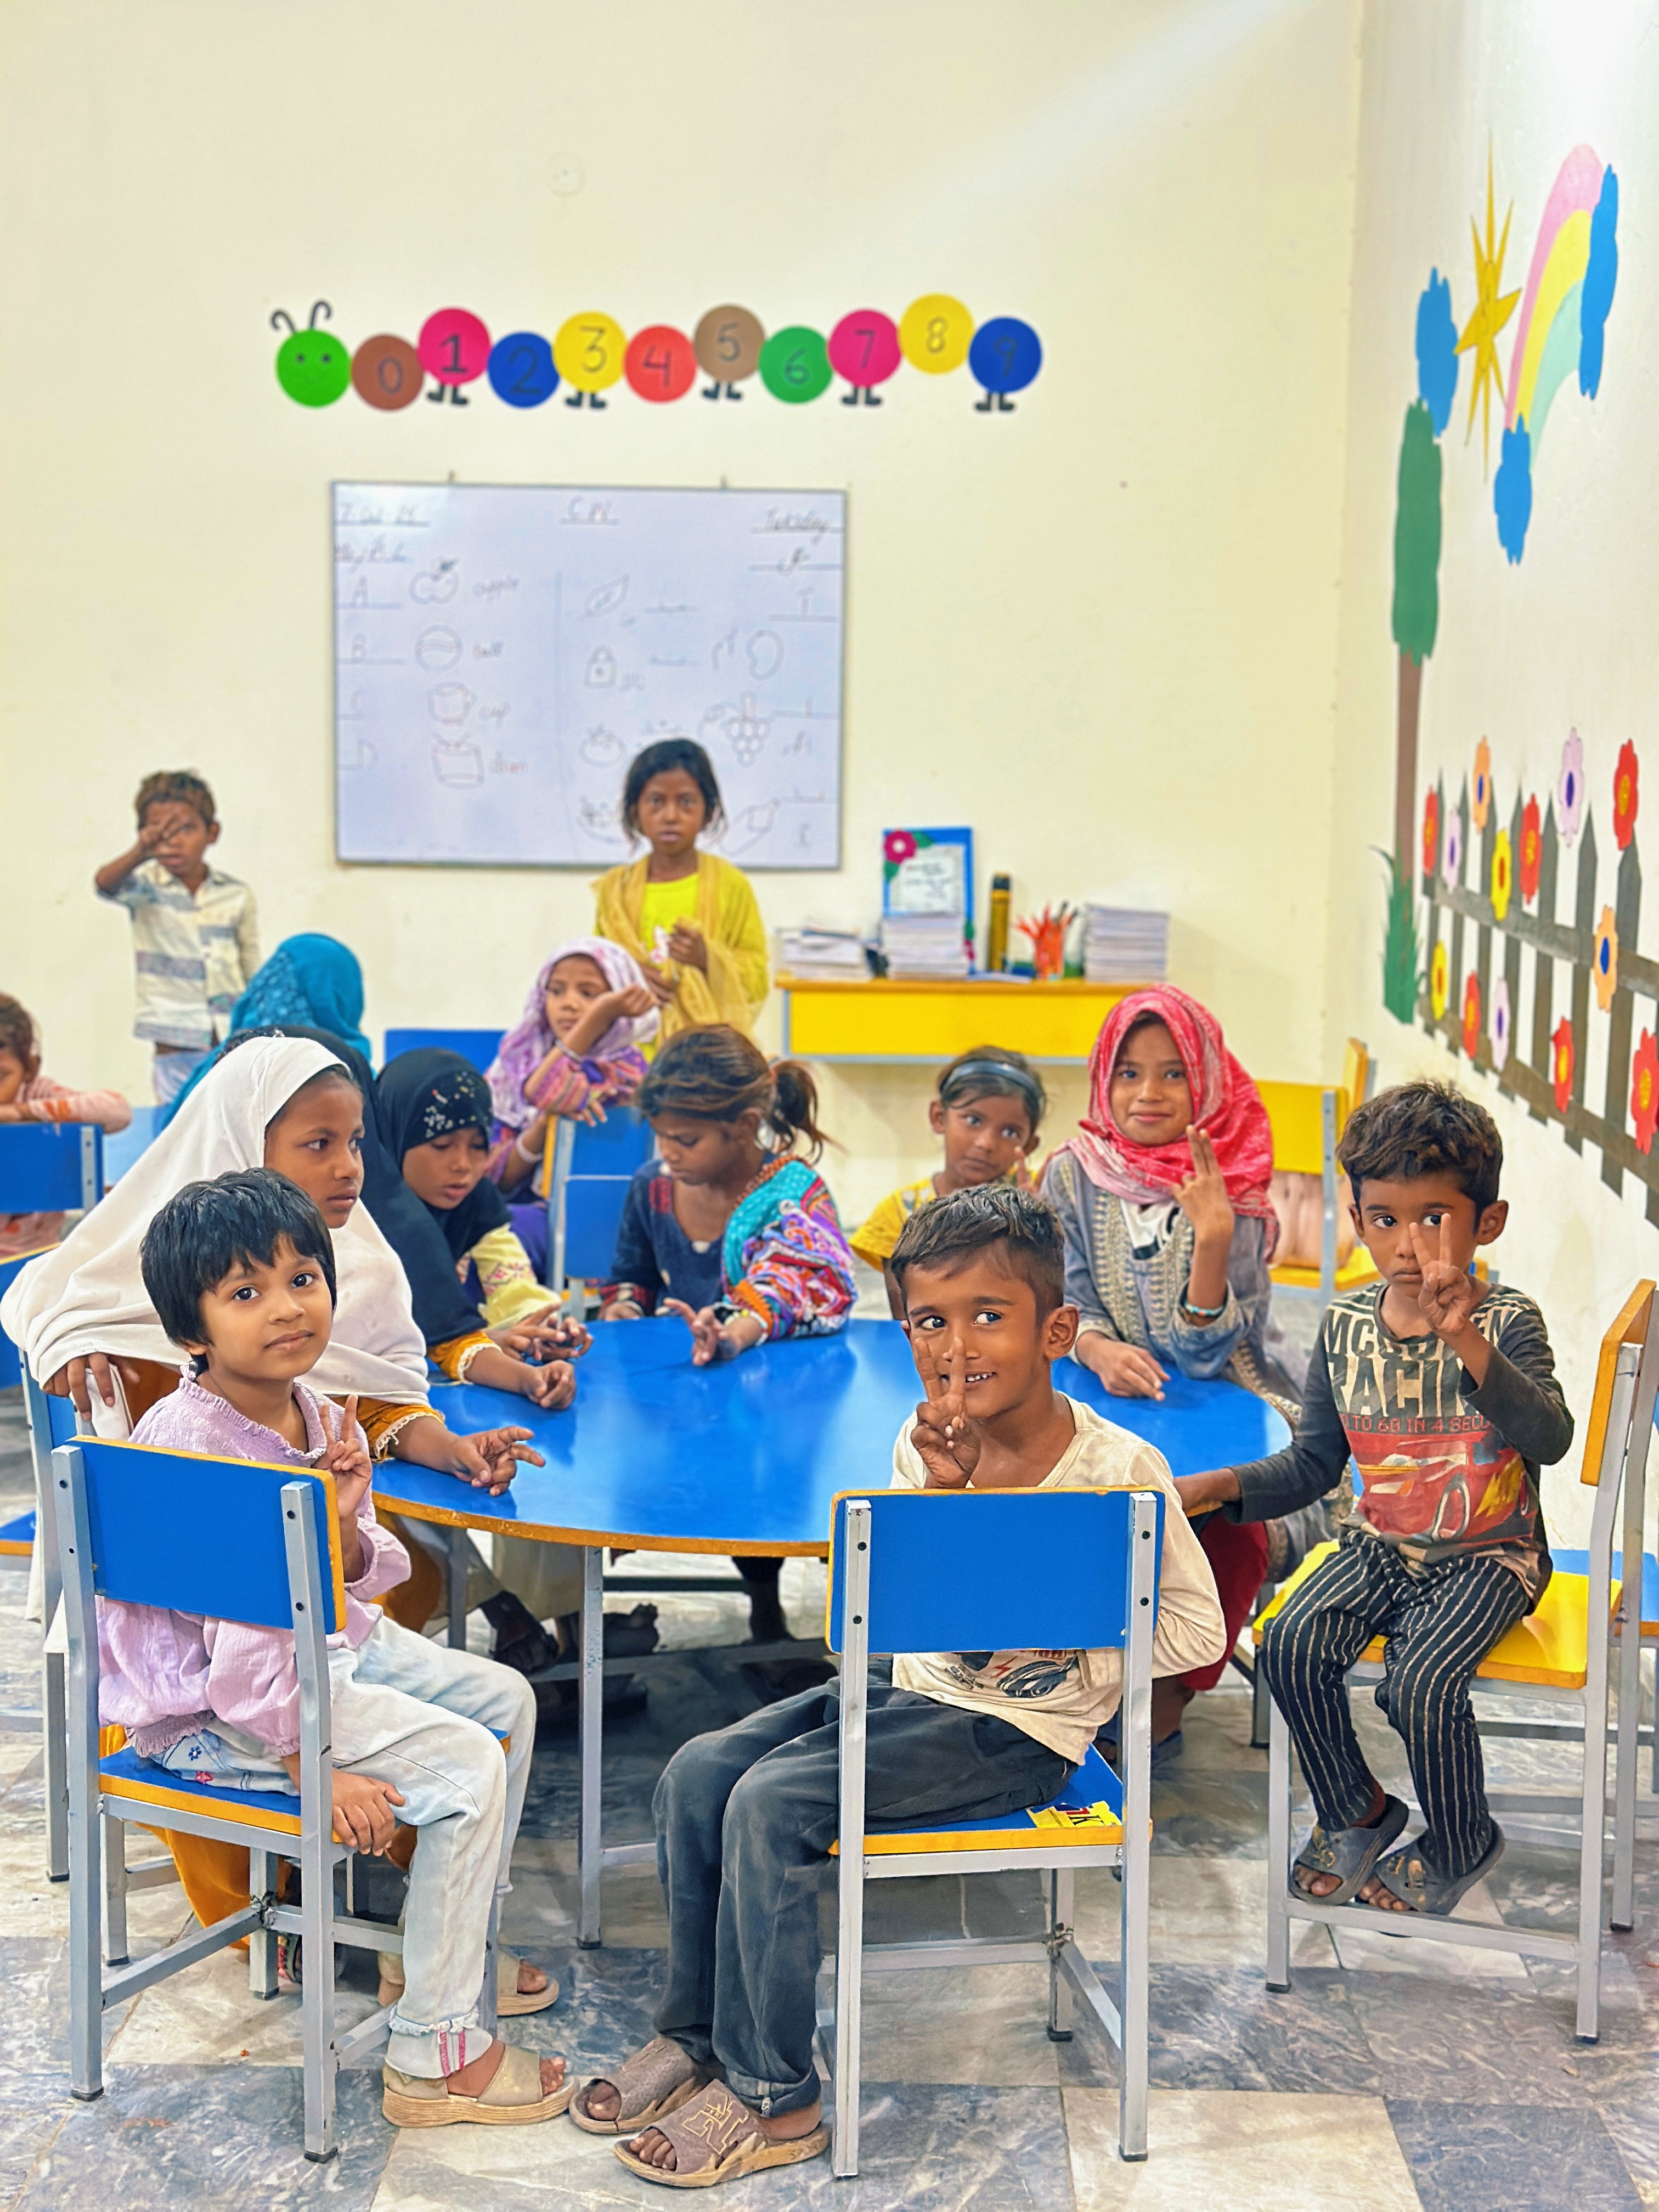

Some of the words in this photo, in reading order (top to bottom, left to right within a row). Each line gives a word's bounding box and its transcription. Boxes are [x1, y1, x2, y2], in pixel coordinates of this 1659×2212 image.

[377, 356, 403, 394] 0
[439, 333, 469, 374] 1
[508, 346, 542, 396] 2
[579, 325, 606, 373] 3
[643, 346, 673, 388] 4
[717, 321, 741, 363] 5
[785, 348, 809, 386] 6
[854, 330, 876, 370] 7
[926, 316, 948, 354] 8
[994, 337, 1018, 377] 9
[349, 574, 369, 608] A
[350, 632, 367, 664] B
[1352, 1415, 1372, 1431] TO
[1406, 1418, 1425, 1434] IN
[1431, 1418, 1443, 1432] 4
